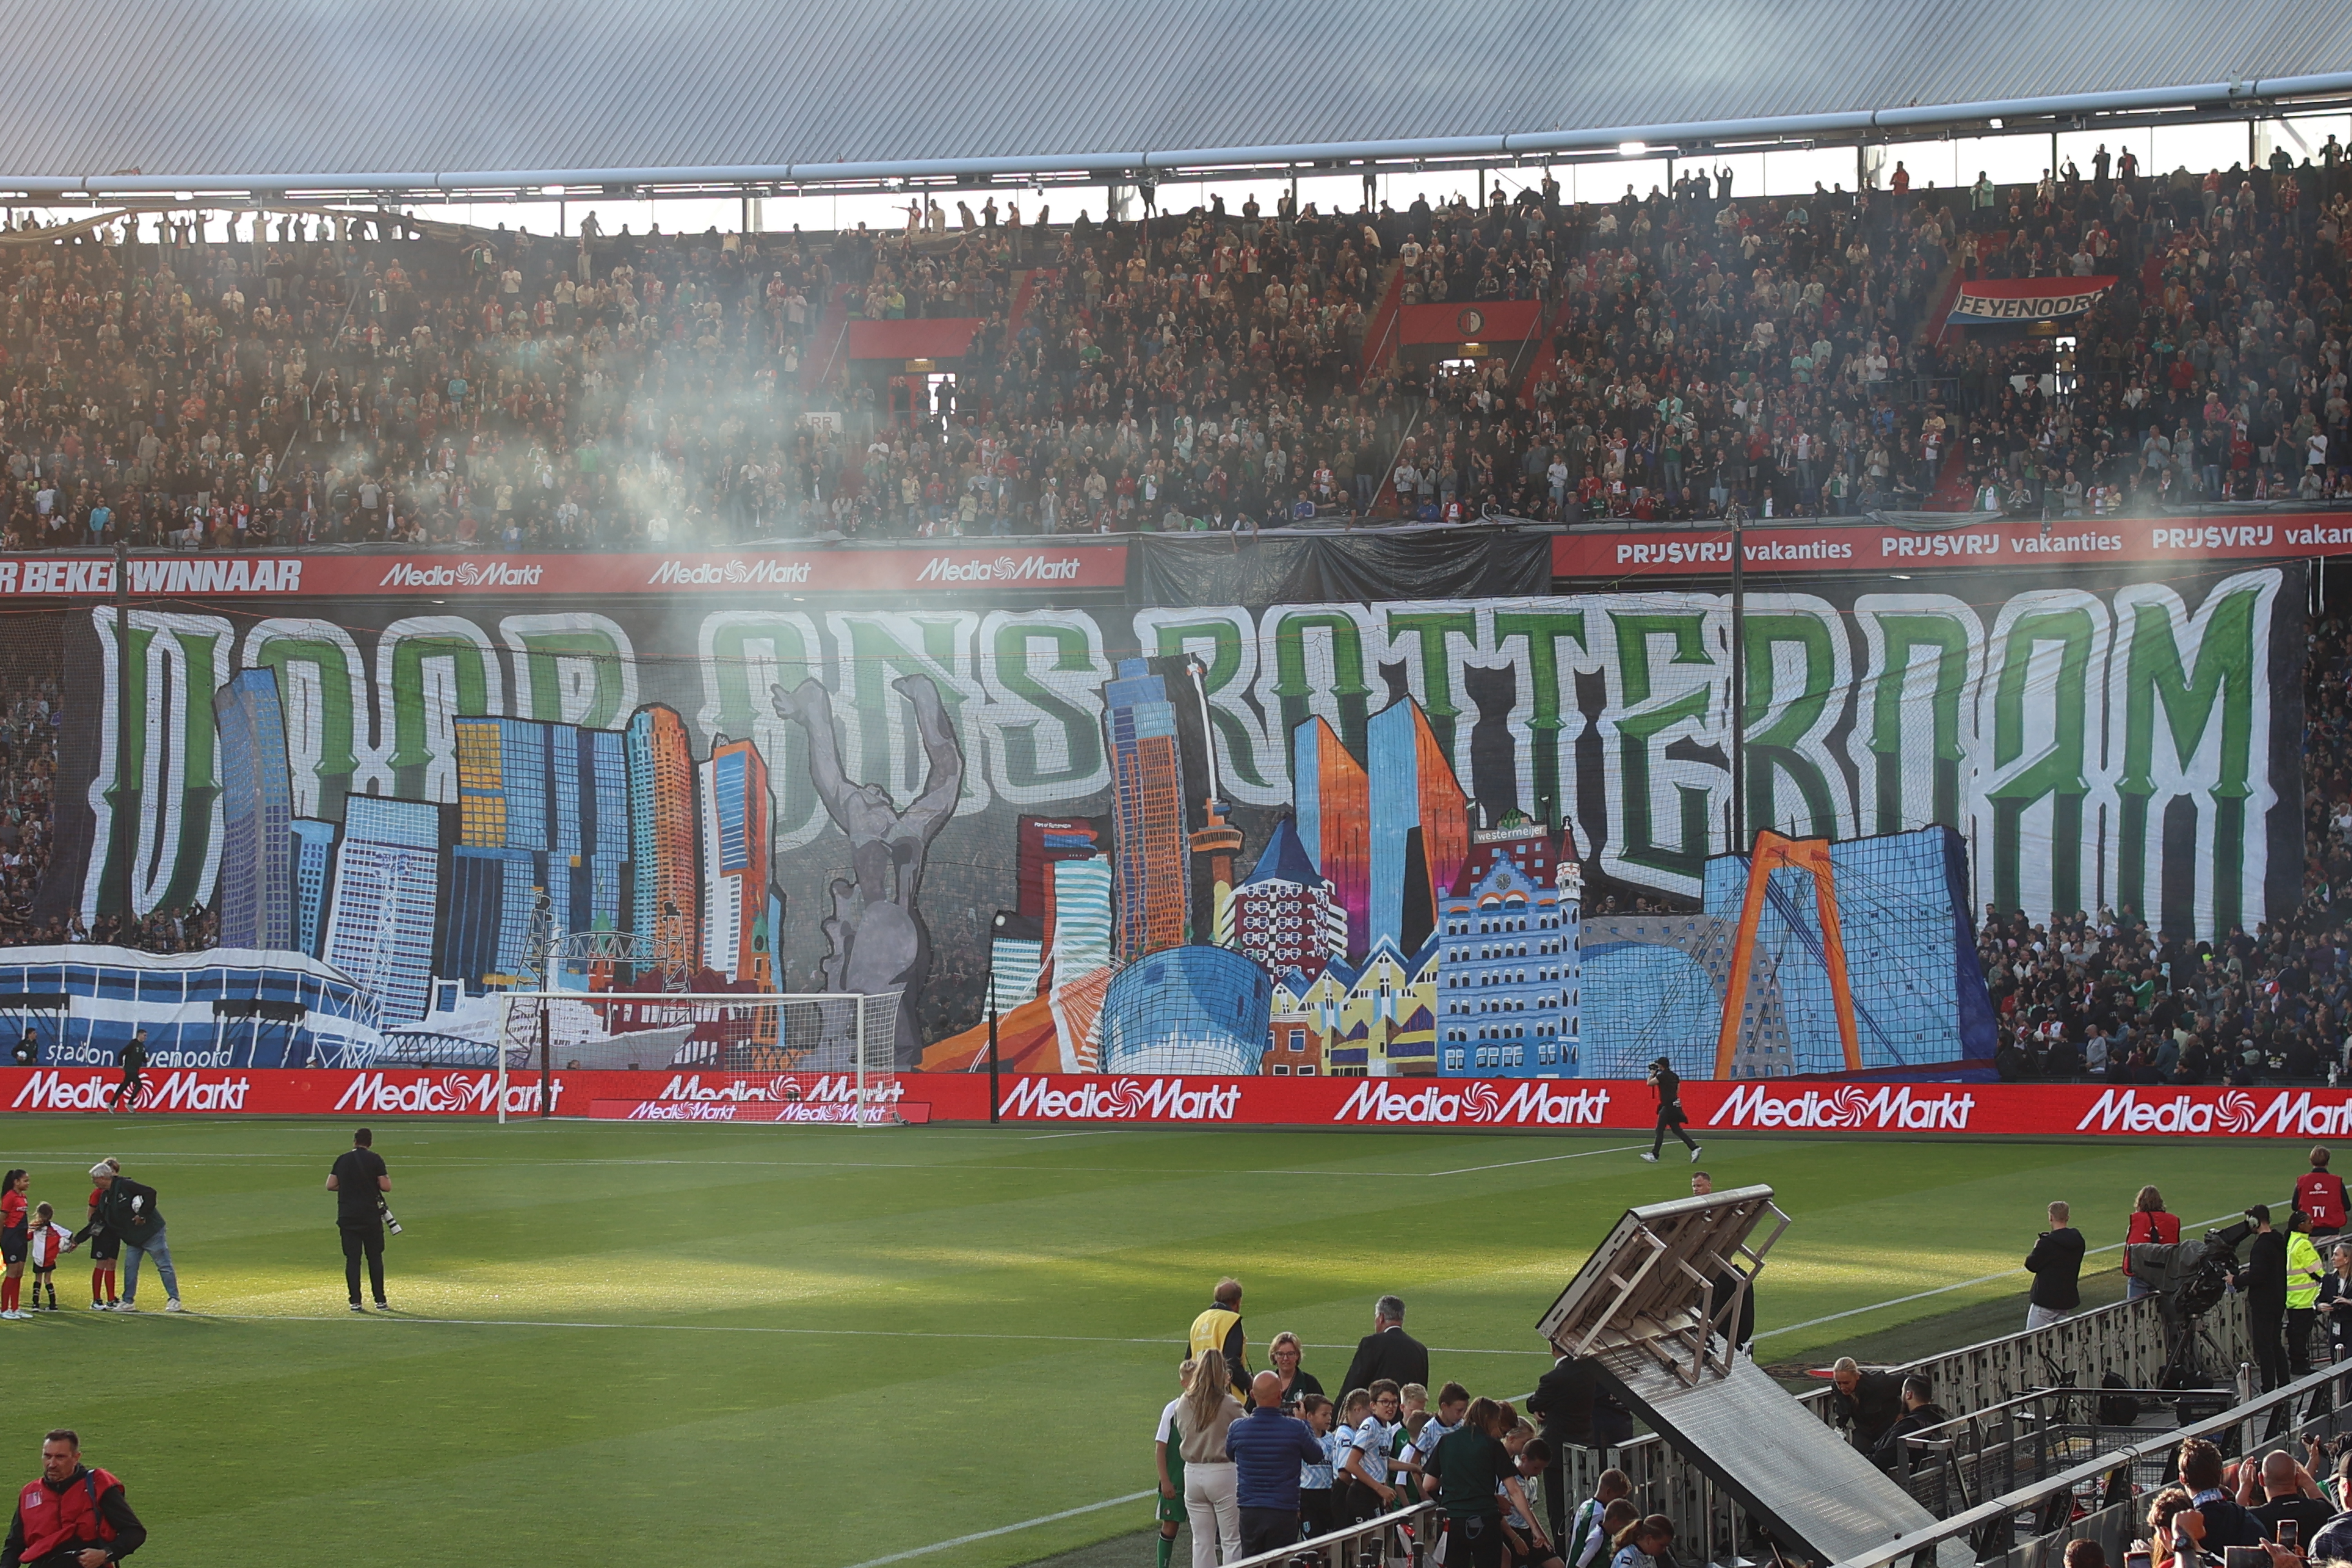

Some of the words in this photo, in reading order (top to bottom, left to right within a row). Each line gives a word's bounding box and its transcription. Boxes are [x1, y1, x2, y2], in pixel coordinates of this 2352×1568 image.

[1743, 539, 1852, 561] vakanties
[2011, 532, 2122, 553] vakanties
[21, 560, 301, 592] BEKERWINNAAR
[379, 563, 455, 586] Media
[475, 562, 543, 585] Markt
[648, 561, 725, 584] Media
[744, 560, 811, 583] Markt
[916, 558, 992, 581] Media
[1012, 556, 1080, 579] Markt
[698, 609, 1113, 851] ONS
[1134, 568, 2283, 943] ROTTERDAM
[1478, 826, 1543, 841] westermeijer
[46, 1041, 114, 1067] stadion
[149, 1072, 250, 1109] Markt
[998, 1077, 1114, 1118] Media
[1139, 1079, 1242, 1119] Markt
[1334, 1080, 1461, 1122] Media
[1494, 1082, 1610, 1123] Markt
[691, 1102, 737, 1120] Markt
[1708, 1085, 1838, 1127] Media
[1864, 1086, 1976, 1129] Markt
[2076, 1089, 2214, 1132] Media
[2312, 1206, 2325, 1218] TV
